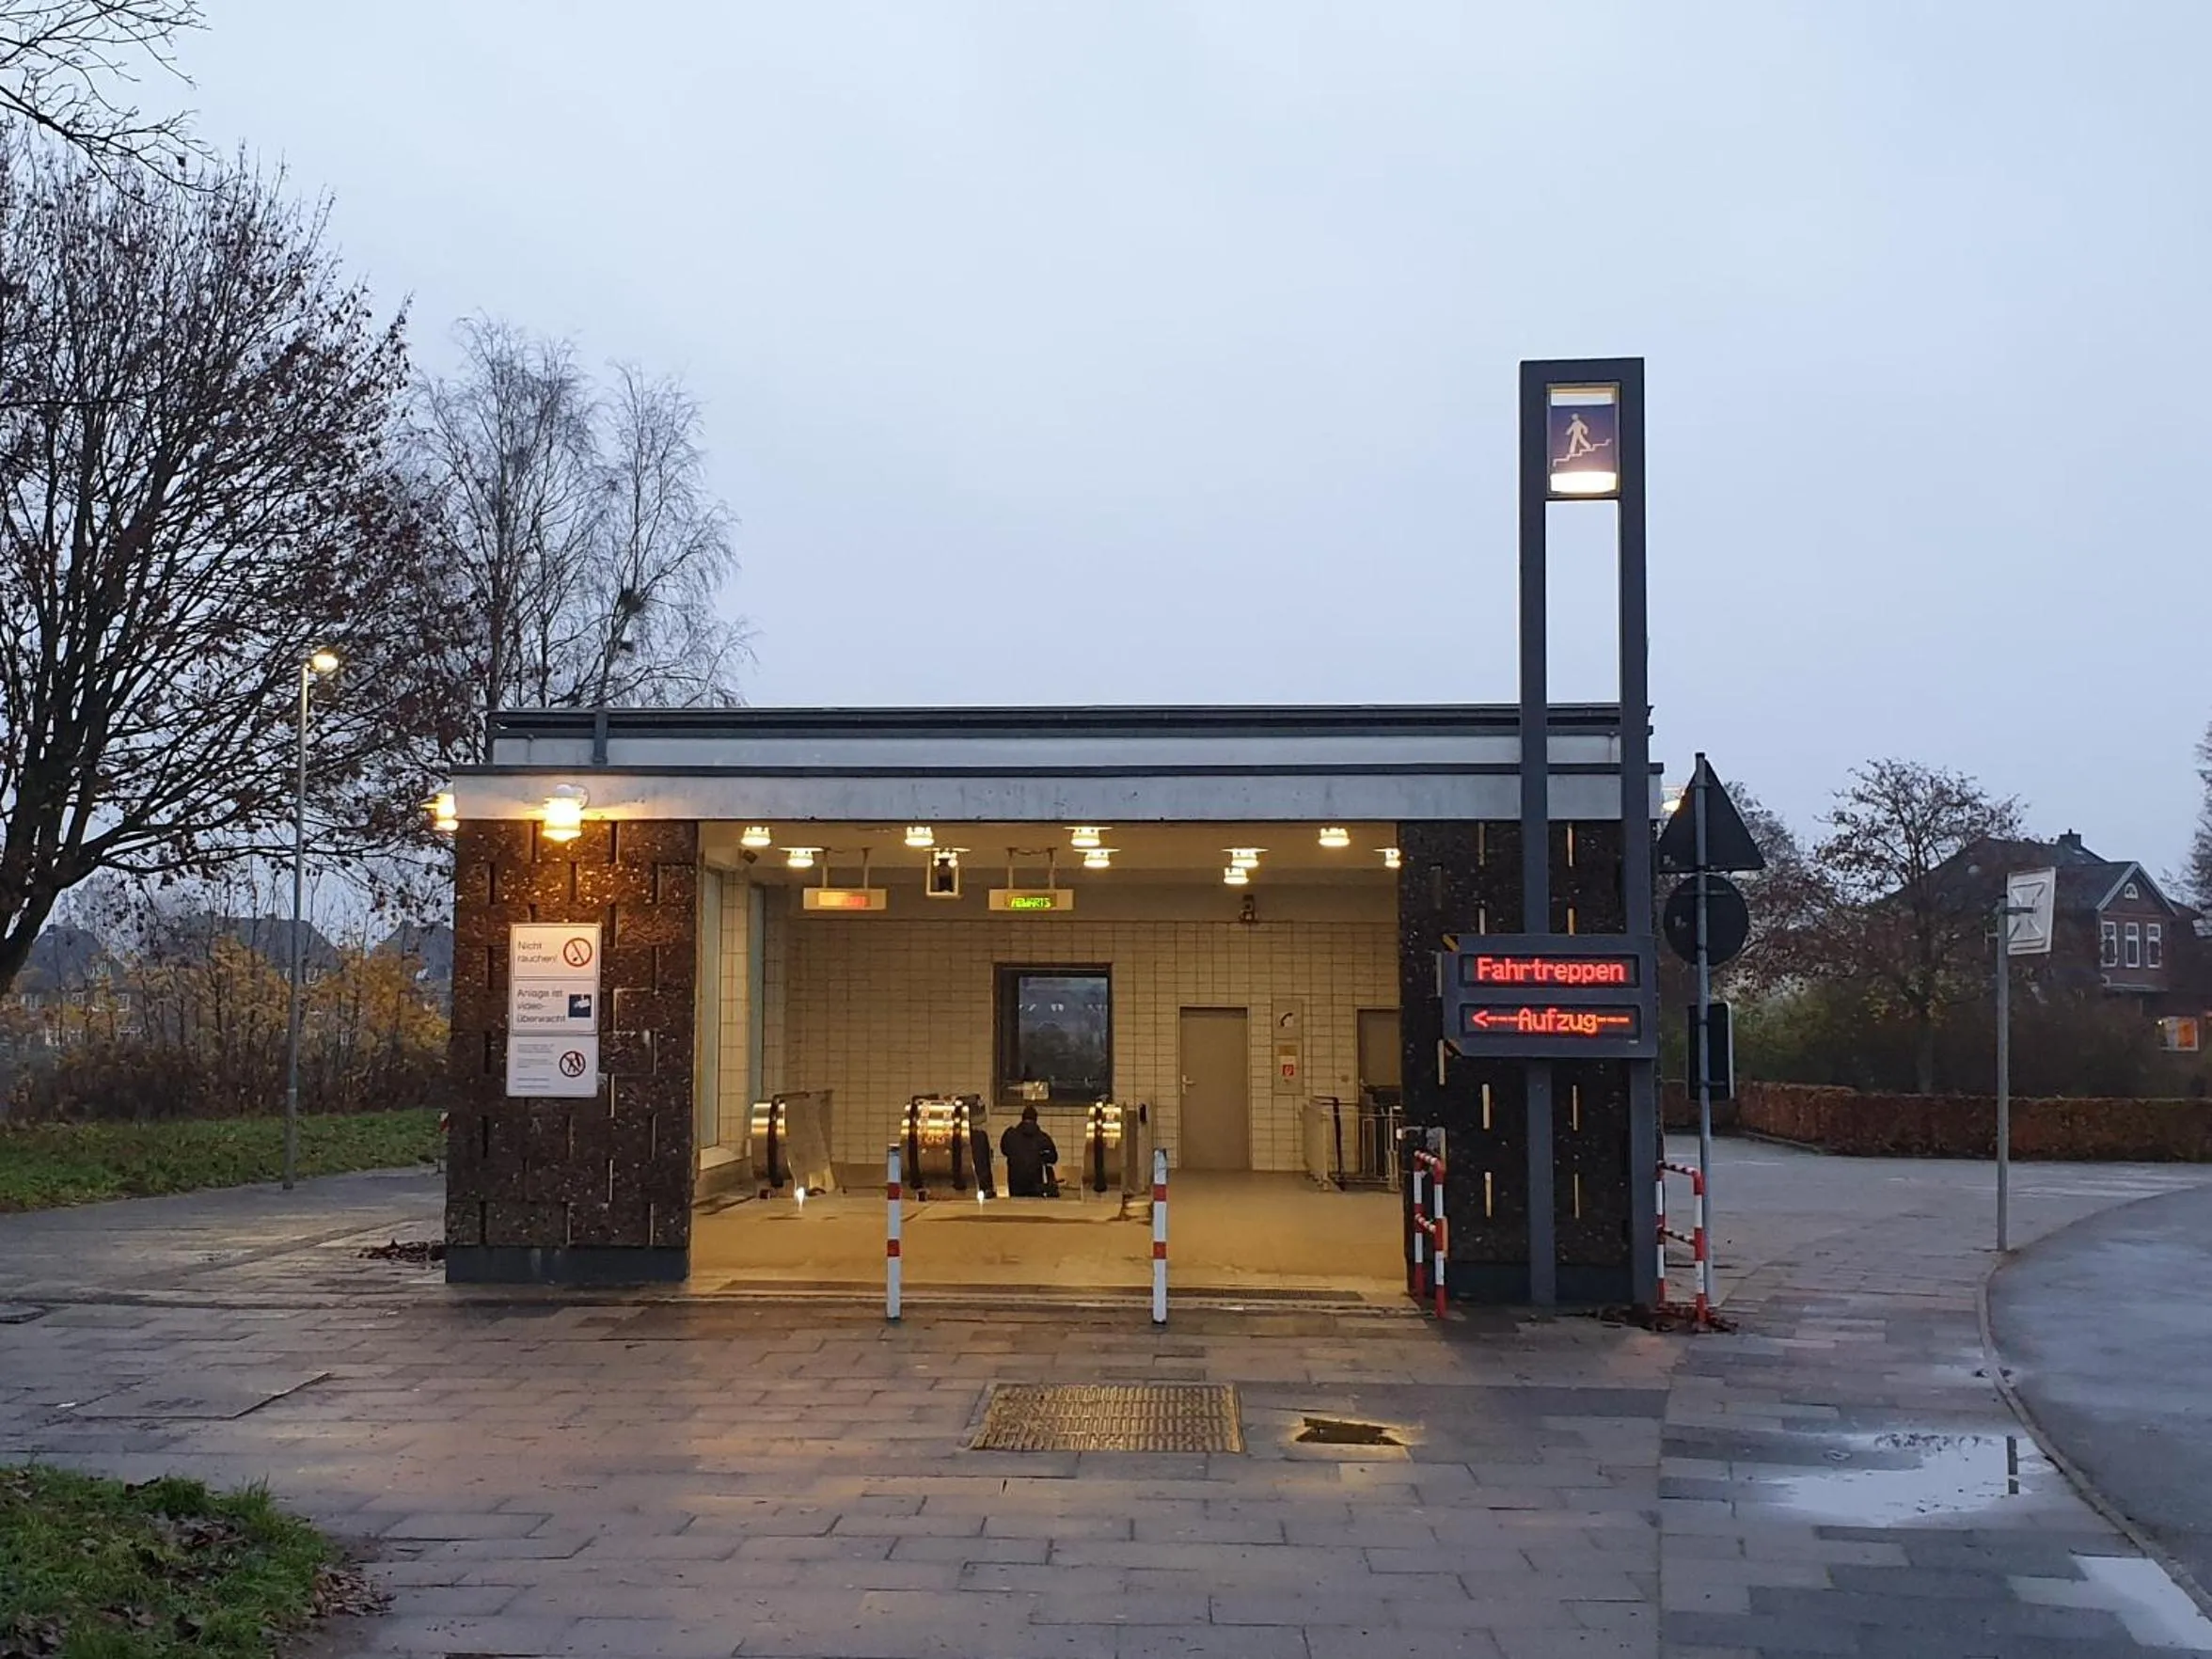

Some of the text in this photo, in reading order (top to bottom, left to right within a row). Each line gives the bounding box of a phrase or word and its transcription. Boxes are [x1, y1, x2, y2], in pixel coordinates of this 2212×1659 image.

[517, 940, 542, 950] Nicht
[1477, 956, 1625, 984] Fahrtreppen
[517, 988, 549, 1000] Anlage
[517, 1013, 566, 1024] überwacht
[1517, 1006, 1599, 1034] Aufzug
